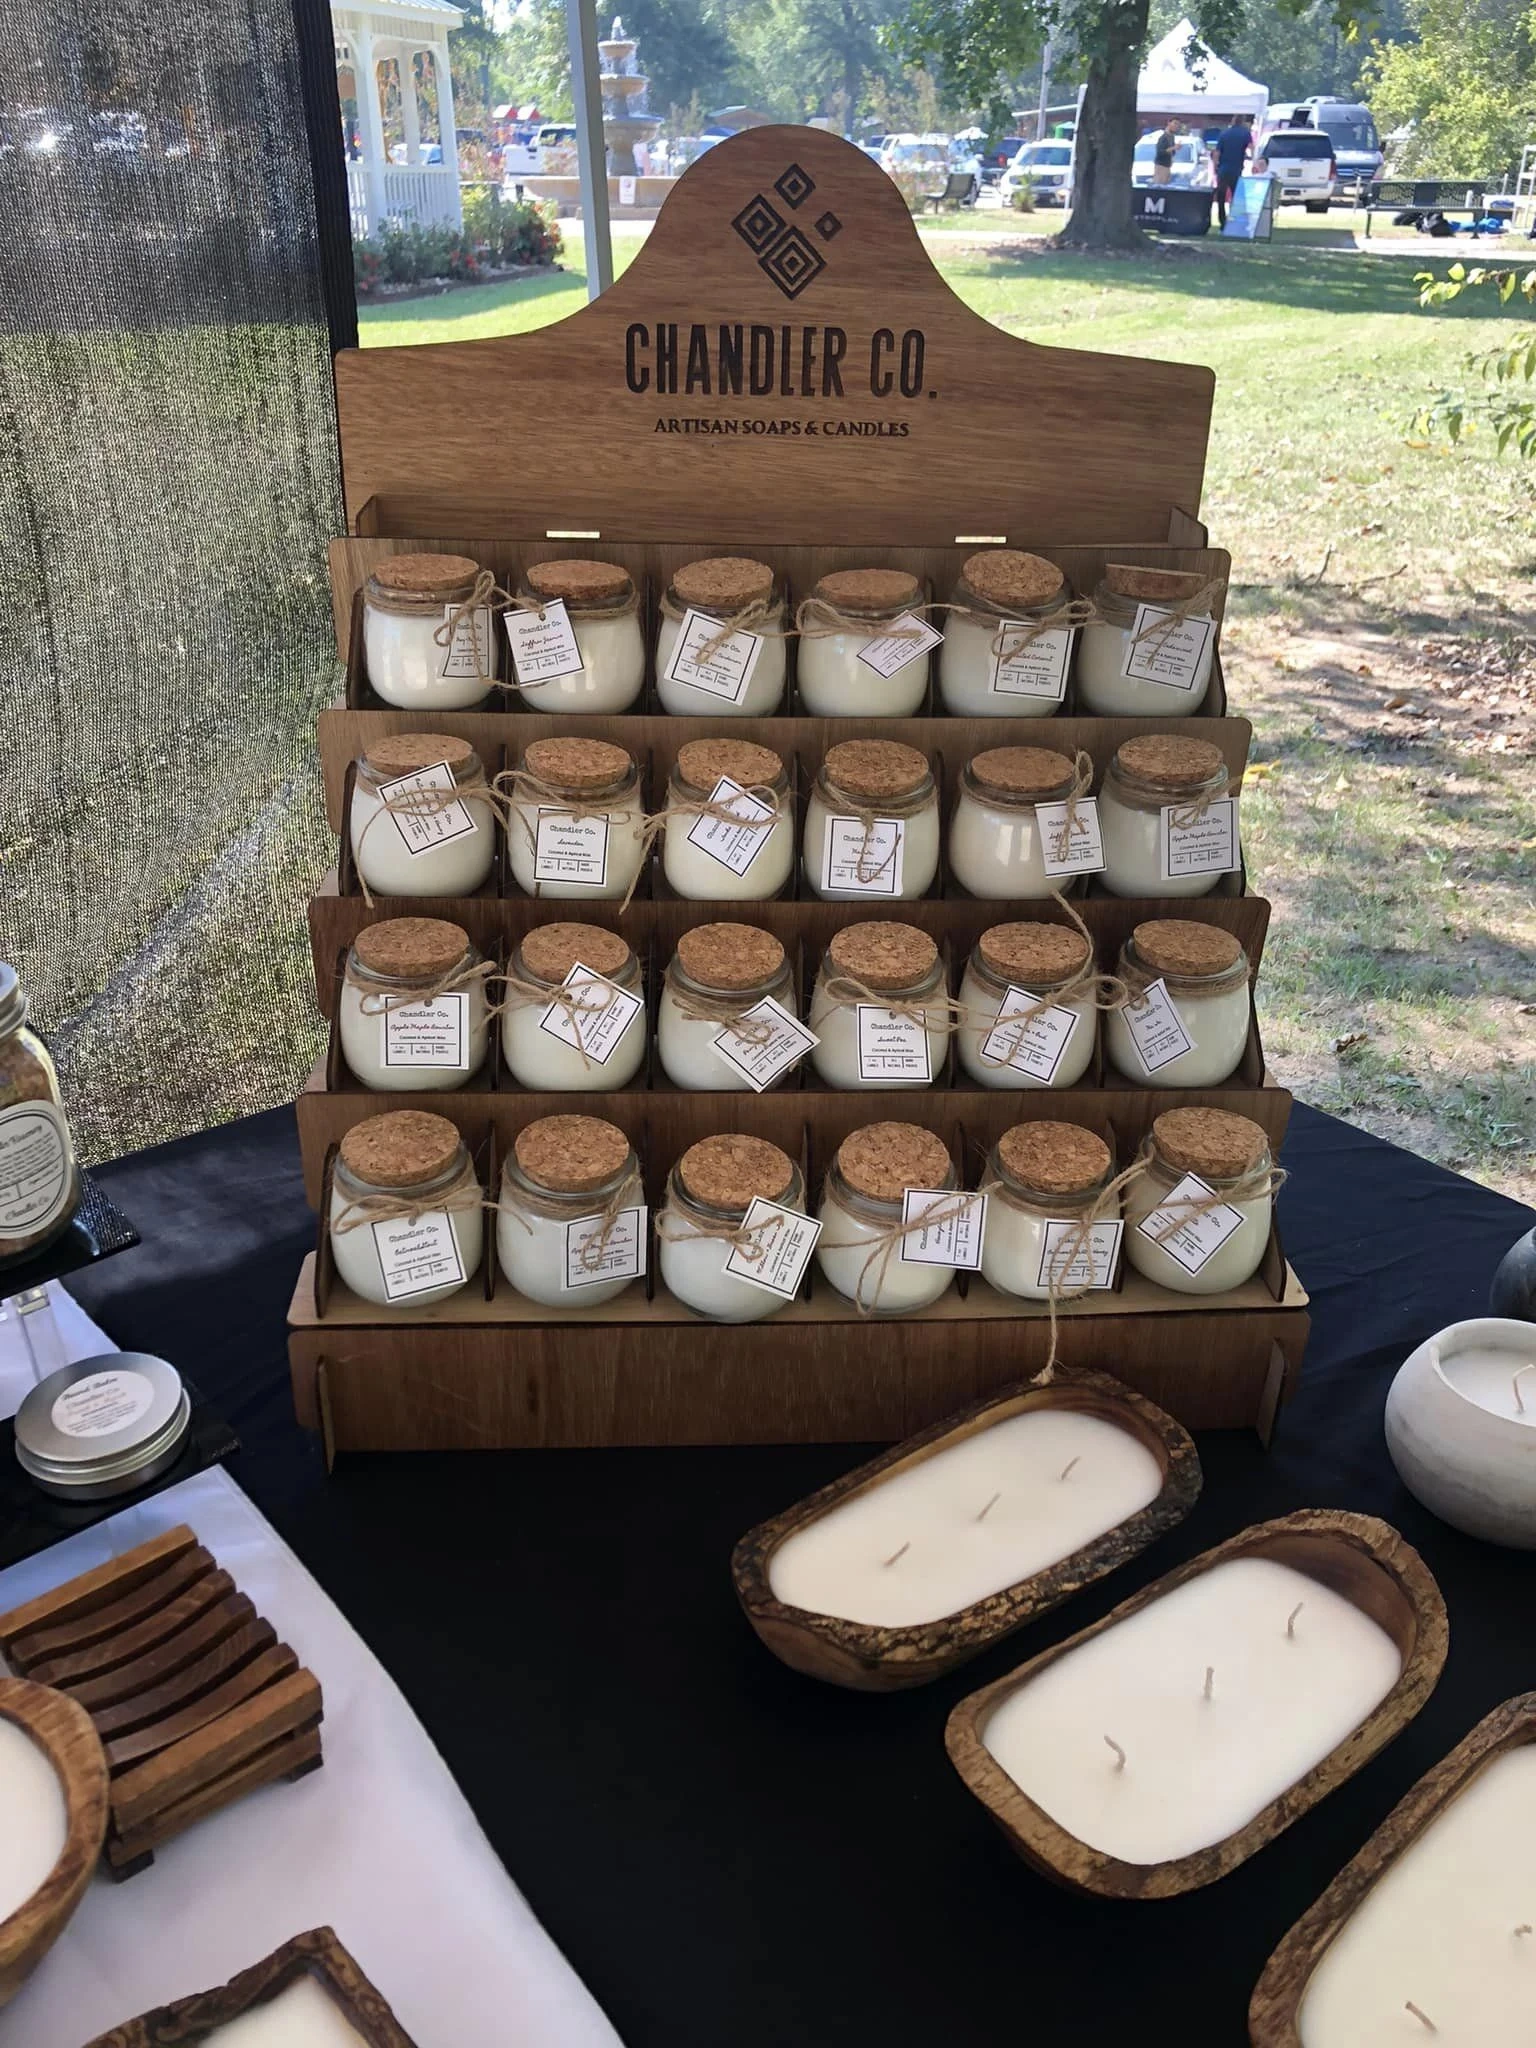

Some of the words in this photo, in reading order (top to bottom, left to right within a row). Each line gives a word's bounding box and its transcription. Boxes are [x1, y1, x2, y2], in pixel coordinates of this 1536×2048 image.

[1144, 197, 1165, 214] M
[626, 323, 847, 397] CHANDLER
[870, 328, 937, 399] CO.
[655, 418, 738, 433] ARTISAN
[743, 419, 800, 435] SOAPS
[804, 421, 817, 435] &
[823, 421, 909, 437] CANDLES
[519, 623, 550, 634] Chandler
[549, 824, 583, 834] Chandler
[584, 828, 596, 836] Co.
[843, 834, 875, 843] Chander
[399, 1010, 435, 1018] Chandler
[436, 1010, 449, 1018] Co.
[390, 1024, 409, 1032] Apple
[870, 1023, 903, 1031] Chandler
[904, 1023, 915, 1031] Co.
[389, 1229, 425, 1243] Chandler
